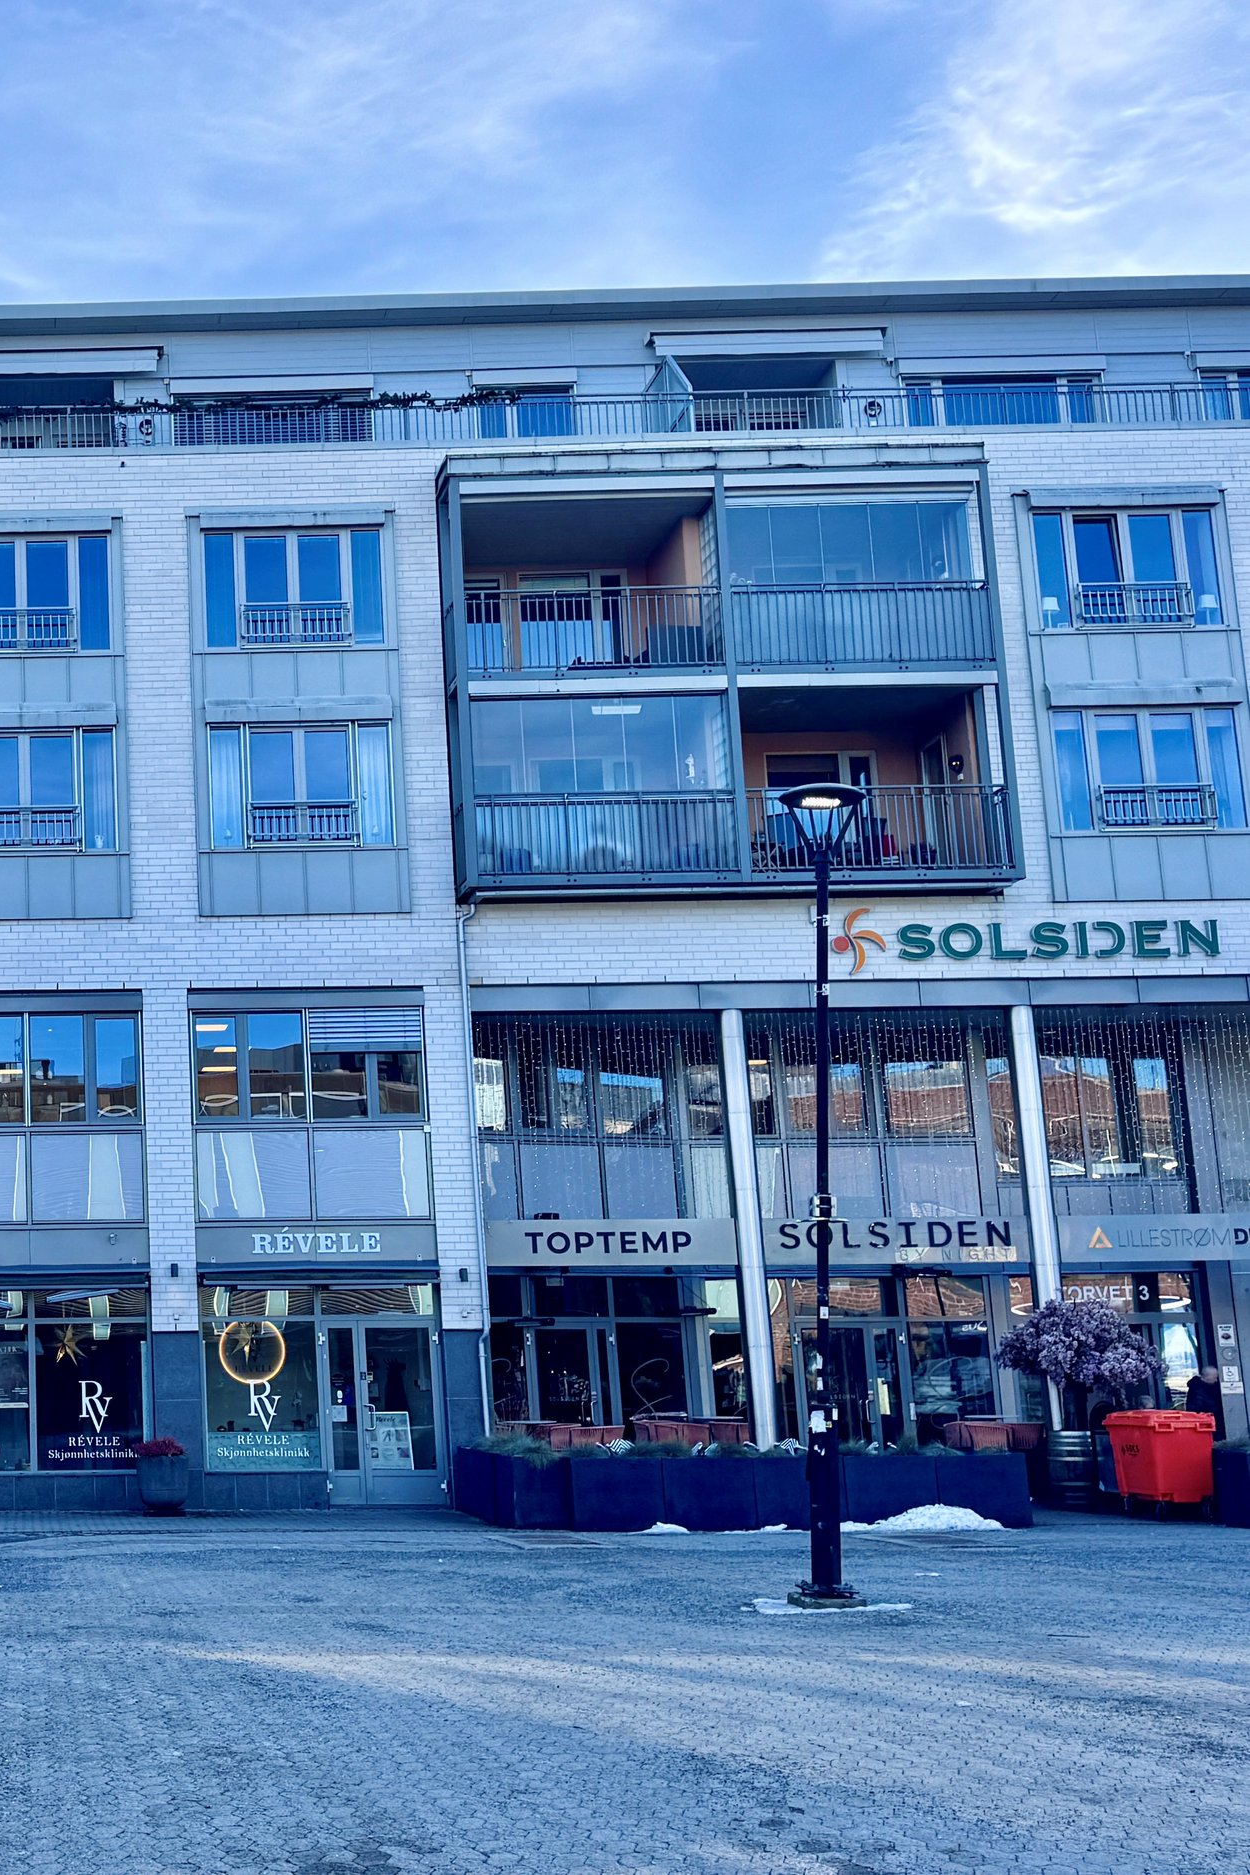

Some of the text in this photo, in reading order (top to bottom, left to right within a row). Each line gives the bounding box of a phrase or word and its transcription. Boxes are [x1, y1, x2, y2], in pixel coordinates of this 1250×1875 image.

[897, 919, 1221, 961] SOLSIDEN
[252, 1226, 381, 1254] RÉVELE
[524, 1231, 692, 1254] TOPTEMP
[779, 1220, 1012, 1250] SOLSIDEN
[1138, 1285, 1150, 1301] 3
[68, 1434, 121, 1447] RÉVELE
[237, 1433, 290, 1445] RÉVELE
[217, 1447, 310, 1459] Skjønnhetsklinikk
